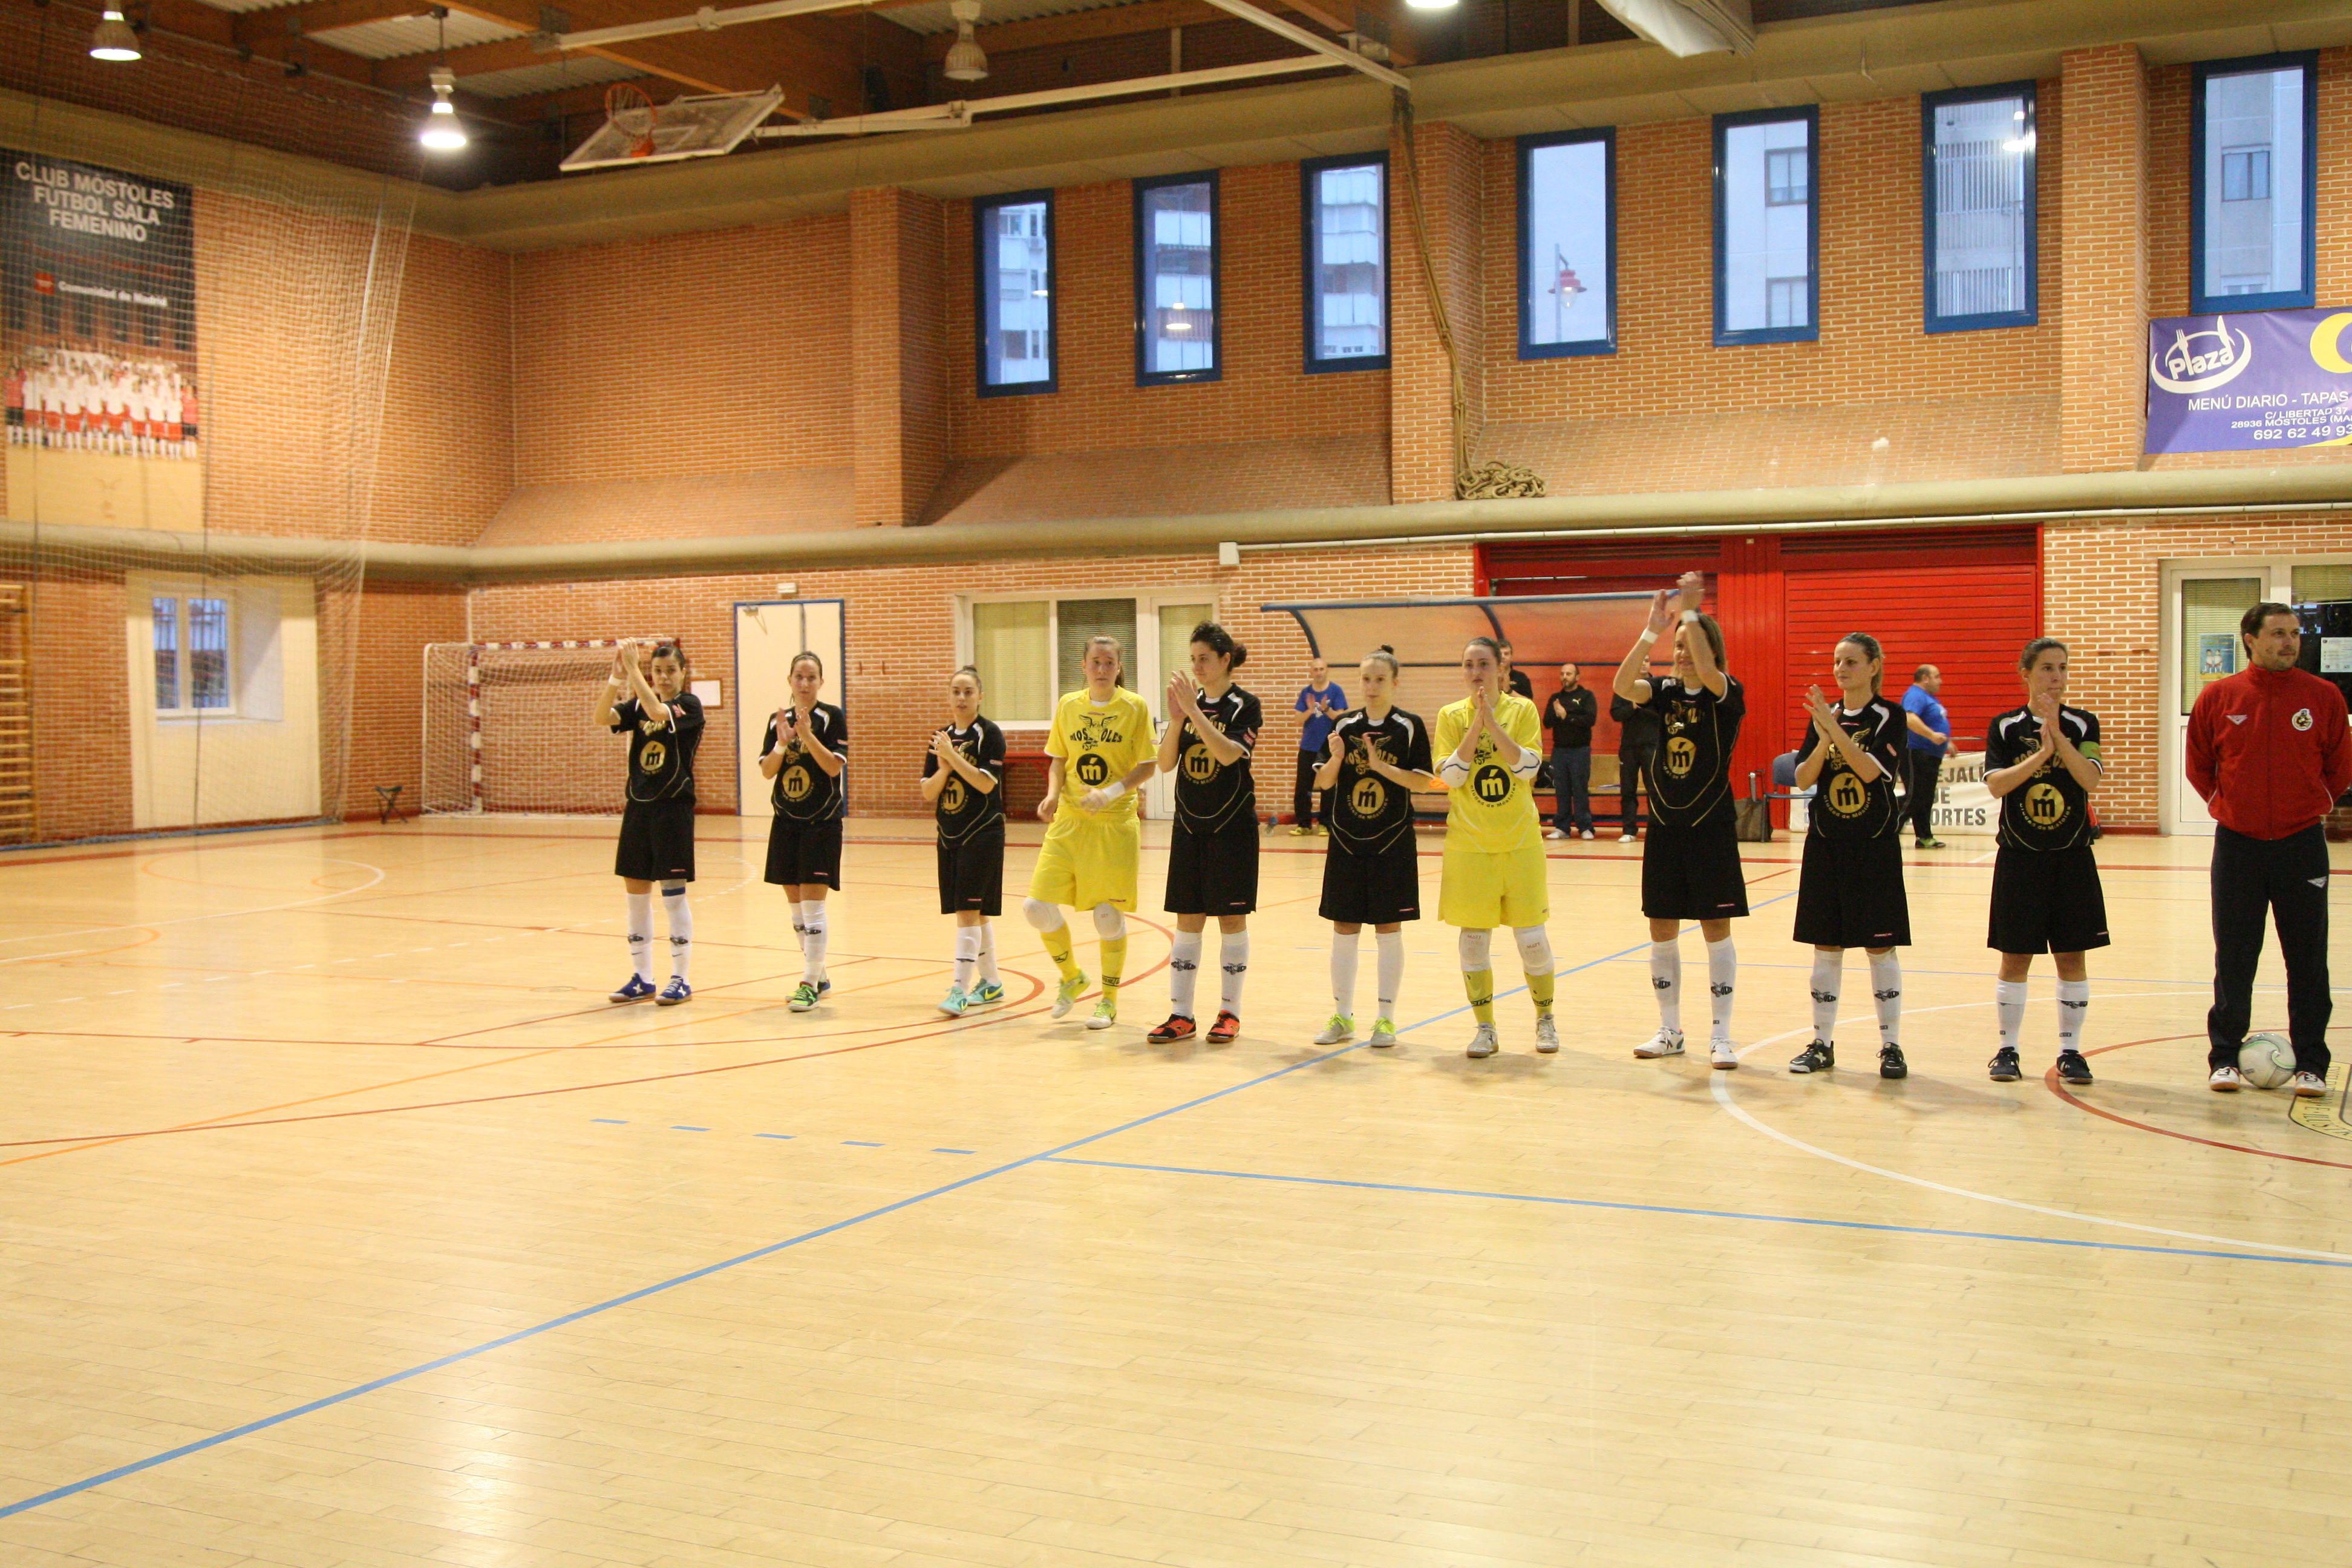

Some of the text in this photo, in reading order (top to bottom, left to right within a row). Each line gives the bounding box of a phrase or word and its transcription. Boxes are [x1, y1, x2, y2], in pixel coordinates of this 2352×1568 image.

[15, 161, 175, 209] CLUB MÓSTOLES
[33, 185, 161, 226] FUTBOL SALA
[49, 208, 148, 242] FEMENINO
[2188, 394, 2231, 411] MENÚ
[2236, 394, 2287, 408] DIARIO
[2301, 391, 2349, 405] TAPAS
[2265, 416, 2327, 427] MÓSTOLES
[2279, 408, 2333, 419] LIBERTAD
[2253, 425, 2352, 440] 692 62 49 93
[1930, 808, 1986, 826] ORTES
